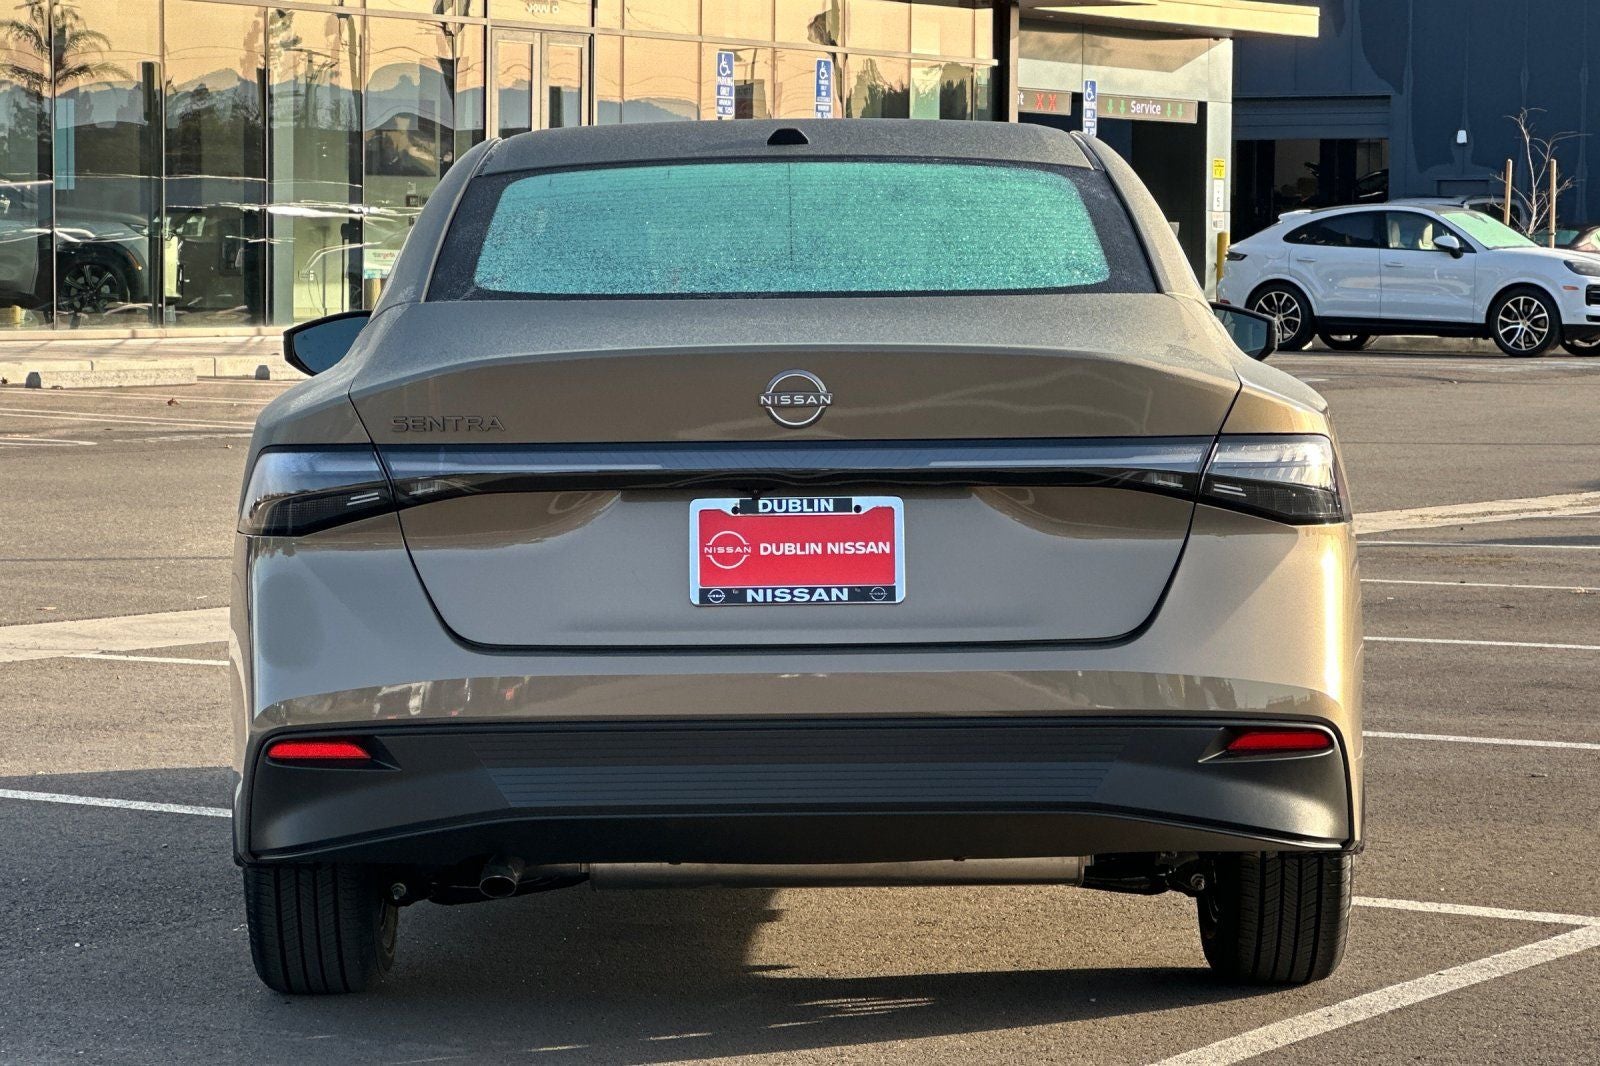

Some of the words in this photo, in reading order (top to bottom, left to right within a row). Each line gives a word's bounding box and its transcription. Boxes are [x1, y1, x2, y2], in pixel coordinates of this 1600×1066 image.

[1131, 100, 1161, 114] Service
[760, 395, 831, 405] NISSAN
[391, 415, 505, 432] SENTRA
[758, 499, 834, 513] DUBLIN
[704, 546, 751, 554] NISSAN
[759, 543, 822, 556] DUBLIN
[827, 541, 890, 555] NISSAN
[746, 588, 848, 603] NISSAN
